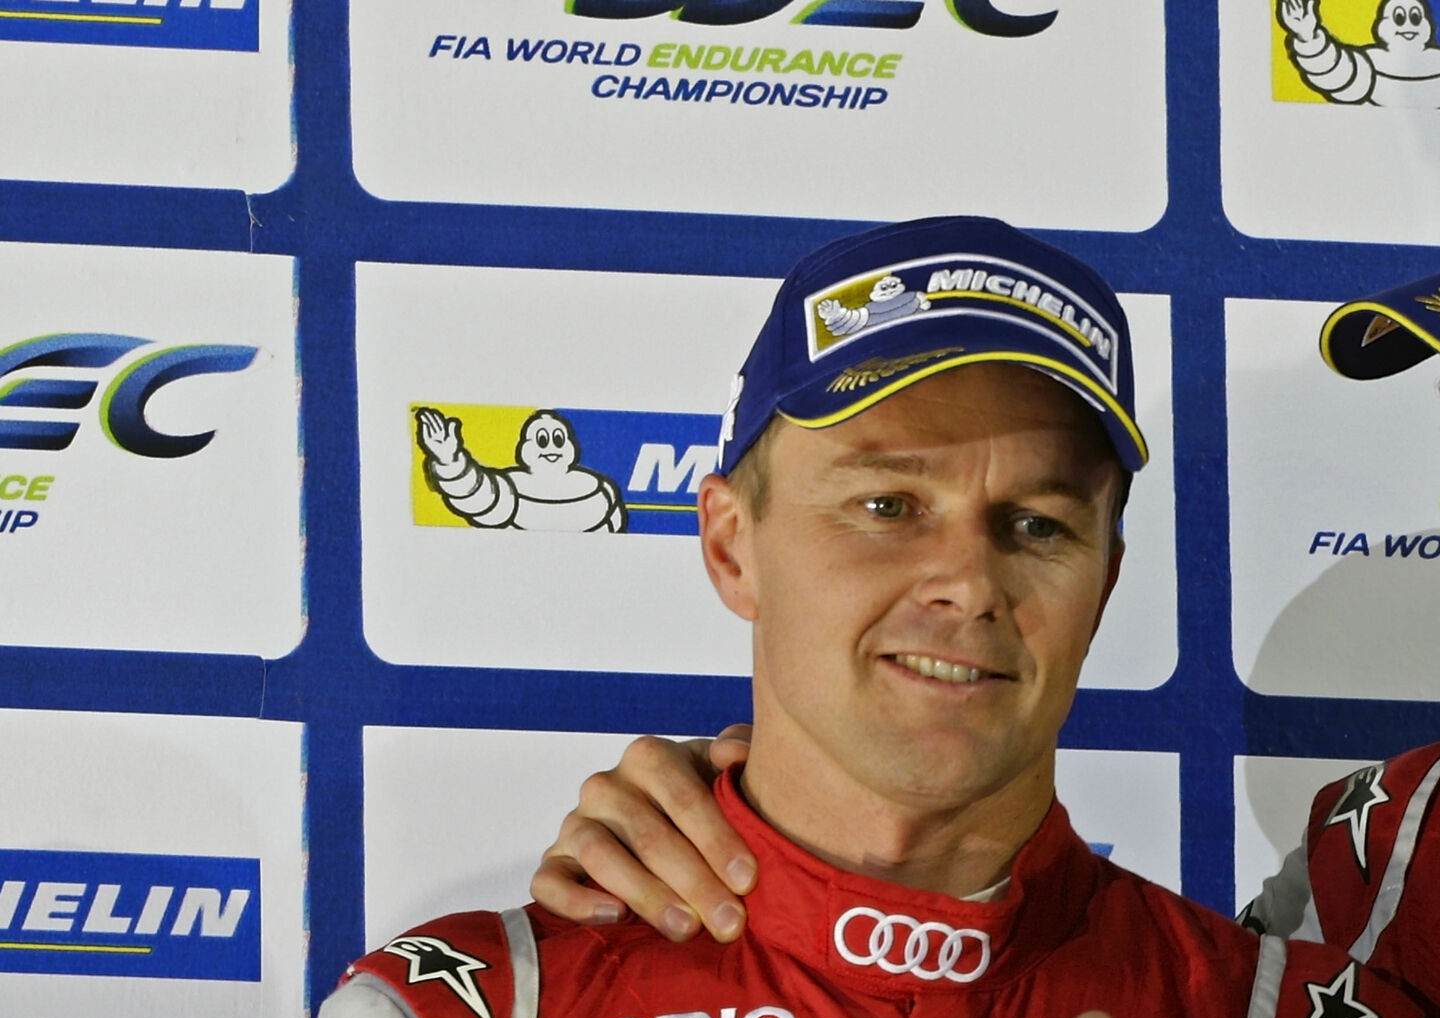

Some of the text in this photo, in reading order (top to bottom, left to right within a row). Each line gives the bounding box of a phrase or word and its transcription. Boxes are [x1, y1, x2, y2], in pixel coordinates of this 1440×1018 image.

[428, 35, 902, 79] FIA WORLD ENDURANCE
[591, 74, 888, 110] CHAMPIONSHIP
[926, 268, 1111, 360] MICHELIN
[0, 333, 260, 459] EC
[1309, 531, 1370, 557] FIA
[0, 880, 250, 938] ELIN
